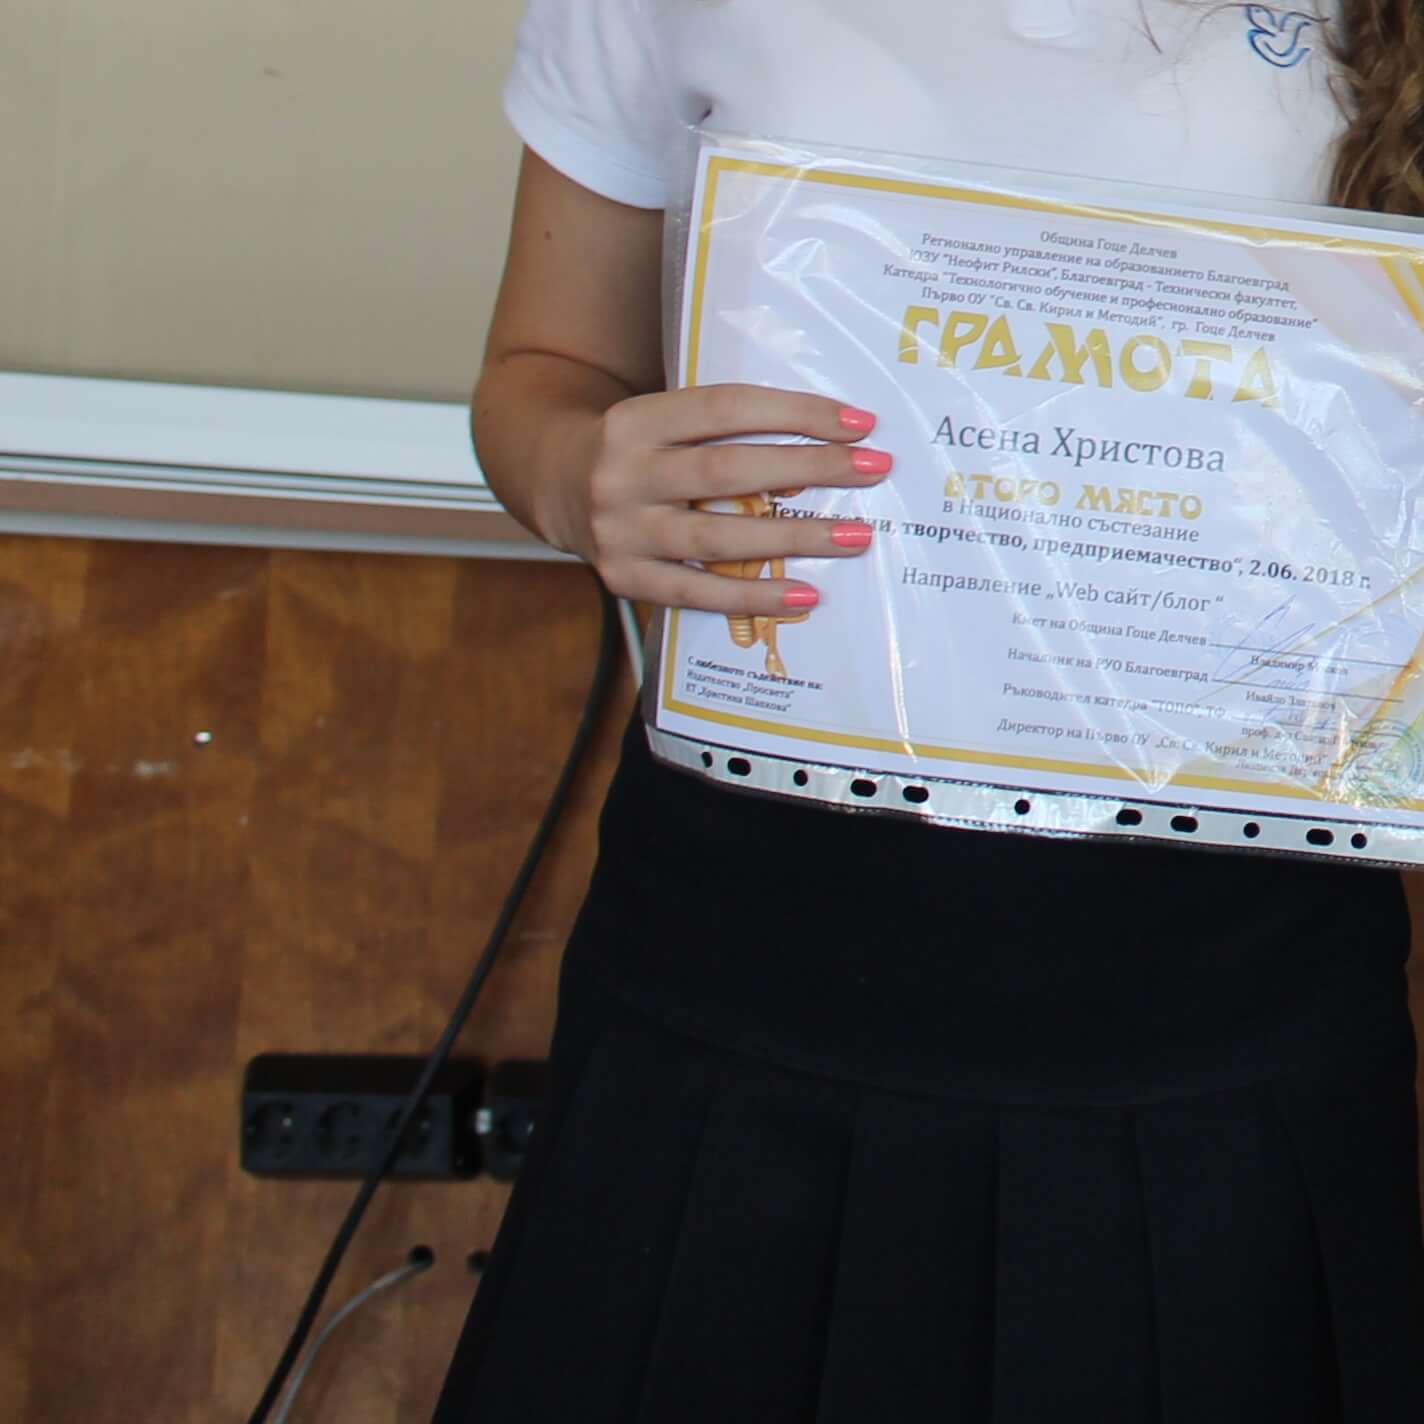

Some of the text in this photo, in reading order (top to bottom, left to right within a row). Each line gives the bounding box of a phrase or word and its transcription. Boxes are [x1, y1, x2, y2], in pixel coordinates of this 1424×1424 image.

[898, 308, 1273, 408] ГРАМОТА
[931, 415, 1224, 472] Асена Христова
[959, 498, 1083, 529] Национално
[1087, 518, 1200, 543] състезание
[902, 522, 1028, 551] творчество,
[1249, 559, 1298, 581] 2.06.
[1302, 566, 1355, 587] 2018
[1359, 576, 1371, 590] г.
[902, 567, 1042, 597] Направление
[1104, 587, 1211, 612] сайт/блог
